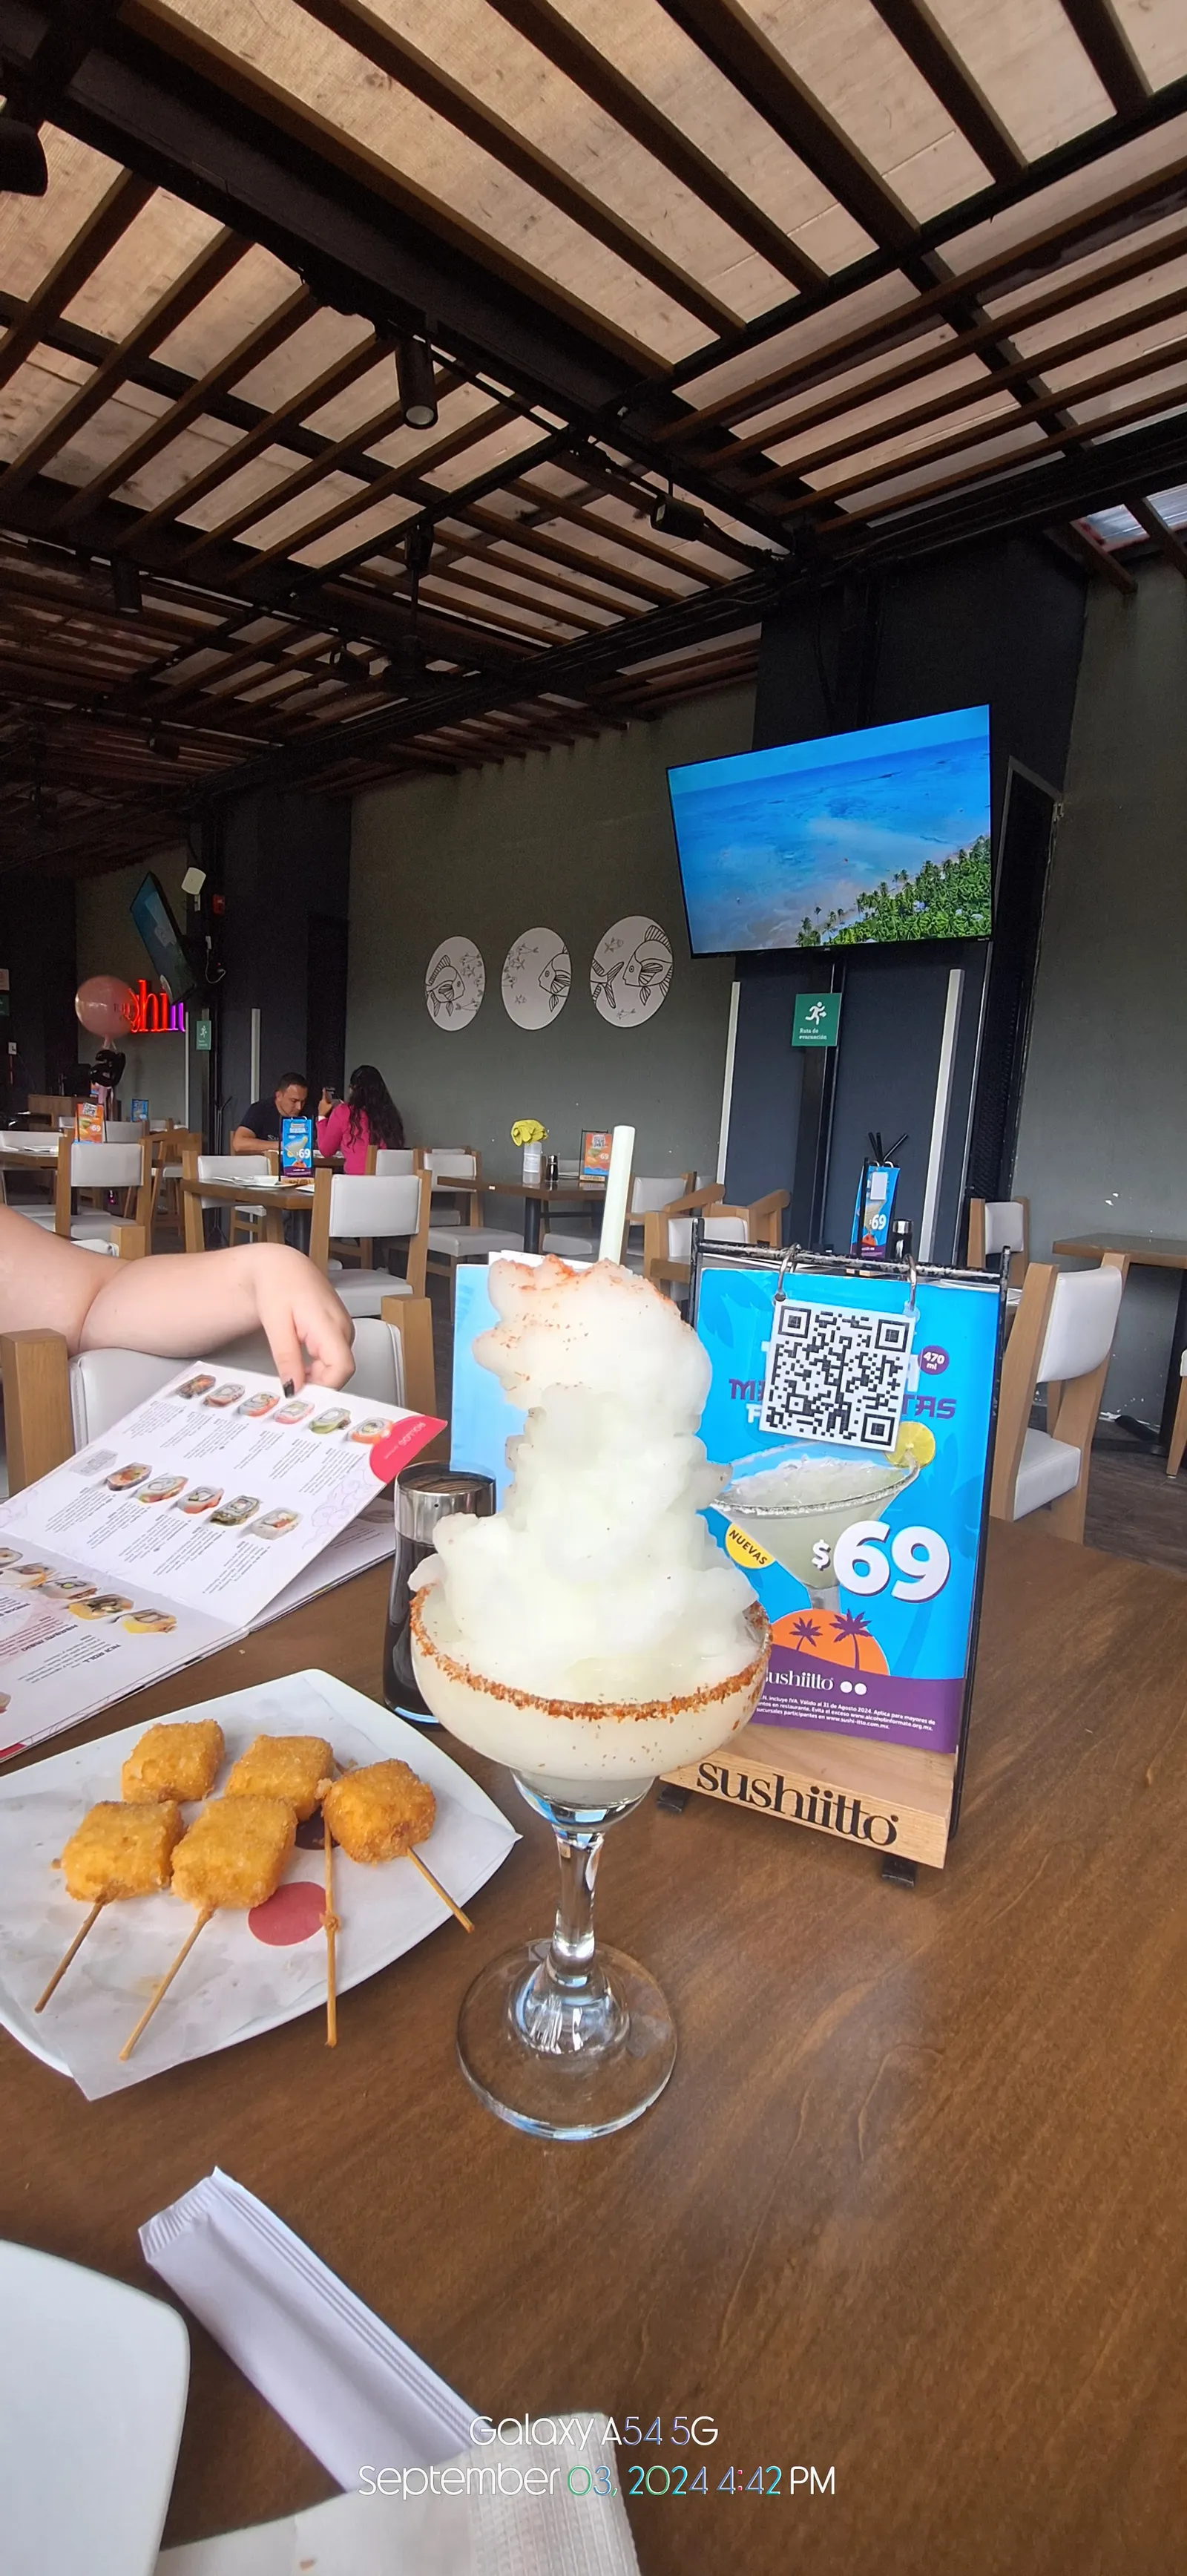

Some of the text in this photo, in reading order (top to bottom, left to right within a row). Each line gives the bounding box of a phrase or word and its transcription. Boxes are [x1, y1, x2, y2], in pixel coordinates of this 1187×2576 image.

[924, 1351, 945, 1364] 470
[729, 1529, 768, 1565] NUEVAS
[766, 1670, 834, 1691] ushiitto
[783, 1710, 818, 1719] participantes
[904, 1715, 927, 1724] mayores
[697, 1762, 899, 1846] sushiitto
